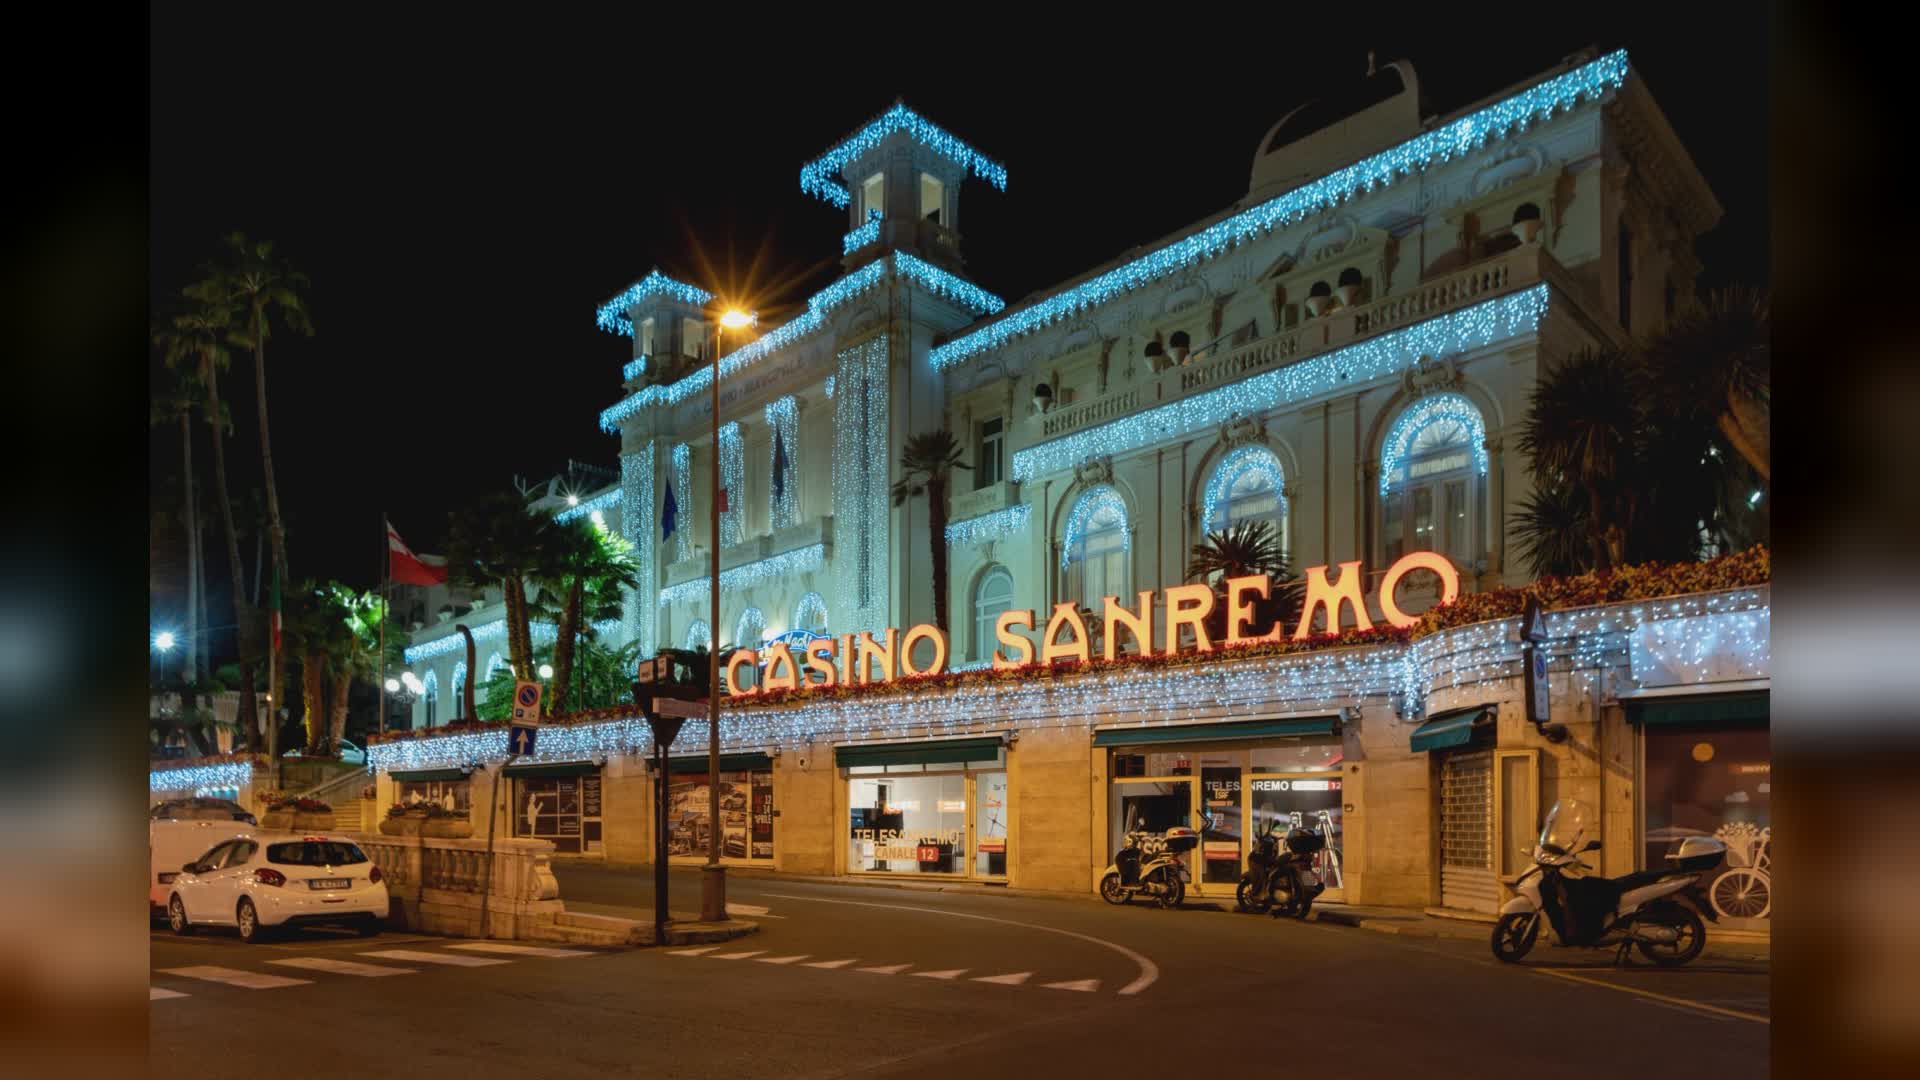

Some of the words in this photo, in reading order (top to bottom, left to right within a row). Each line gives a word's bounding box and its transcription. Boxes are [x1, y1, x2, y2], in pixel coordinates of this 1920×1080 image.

[727, 623, 949, 697] CASINO
[993, 551, 1460, 670] SANREMO
[1205, 780, 1289, 792] TELESNREMO
[1330, 781, 1342, 791] 12
[875, 847, 916, 860] CANALE
[921, 848, 935, 860] 12
